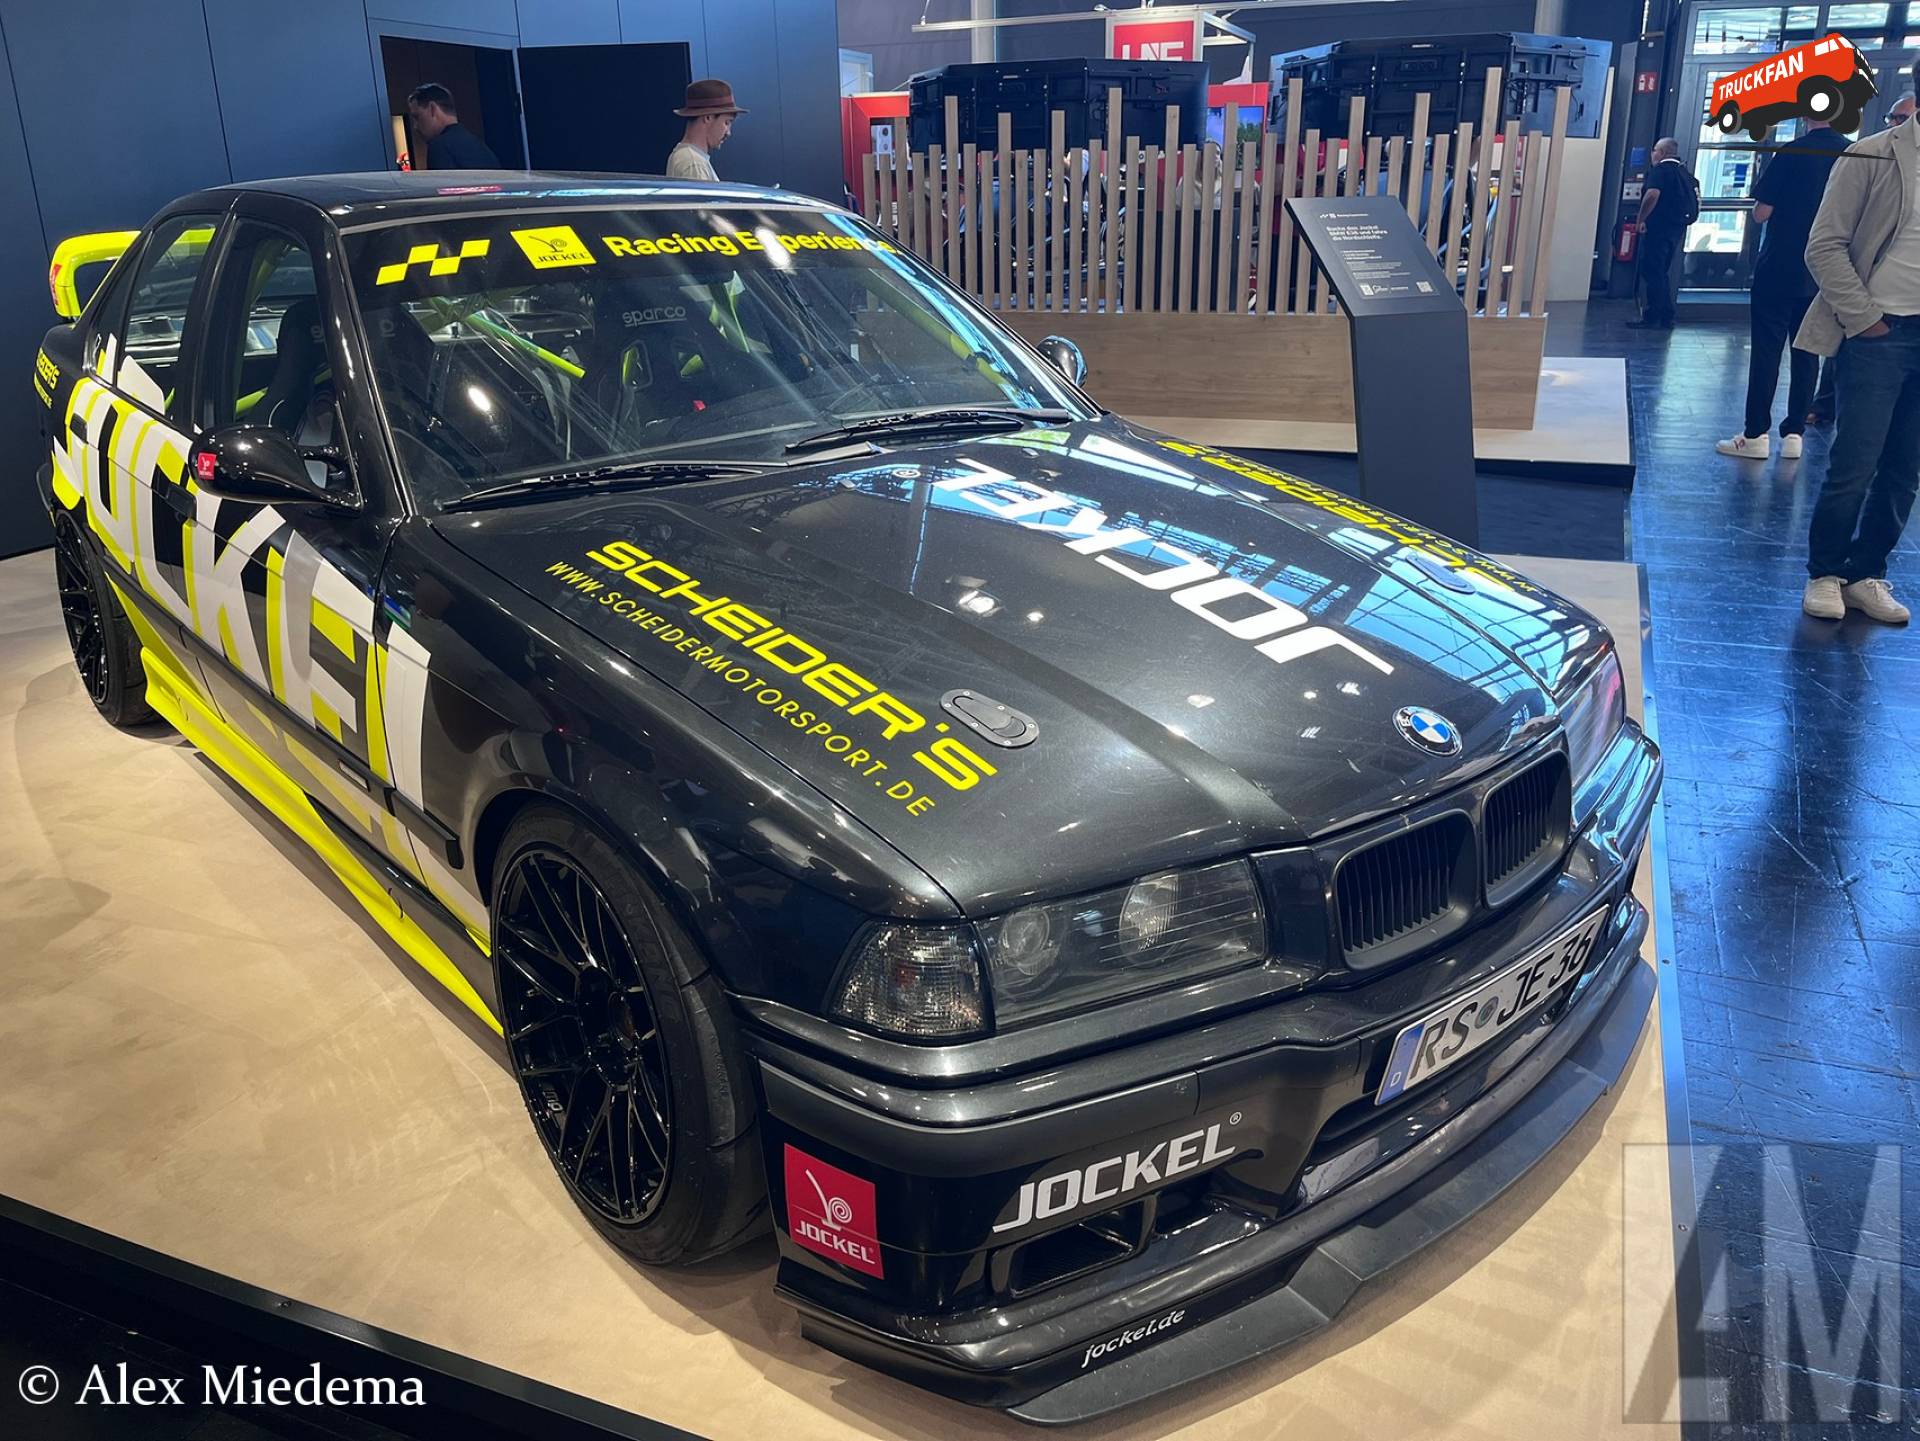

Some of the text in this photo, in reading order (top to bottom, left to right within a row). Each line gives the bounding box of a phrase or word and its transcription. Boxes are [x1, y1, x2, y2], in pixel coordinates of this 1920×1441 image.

[536, 252, 590, 263] JOCKEL
[601, 232, 741, 257] Racing
[621, 304, 687, 327] sparco
[585, 540, 998, 791] SCHEIDER'S
[544, 561, 936, 817] WWW.SCHEIDERMOTORSPORT.DE
[1409, 922, 1597, 1080] RS JE 36
[1390, 1071, 1402, 1088] D
[795, 1219, 875, 1264] JOCKEL
[1080, 1307, 1185, 1369] jockel.de
